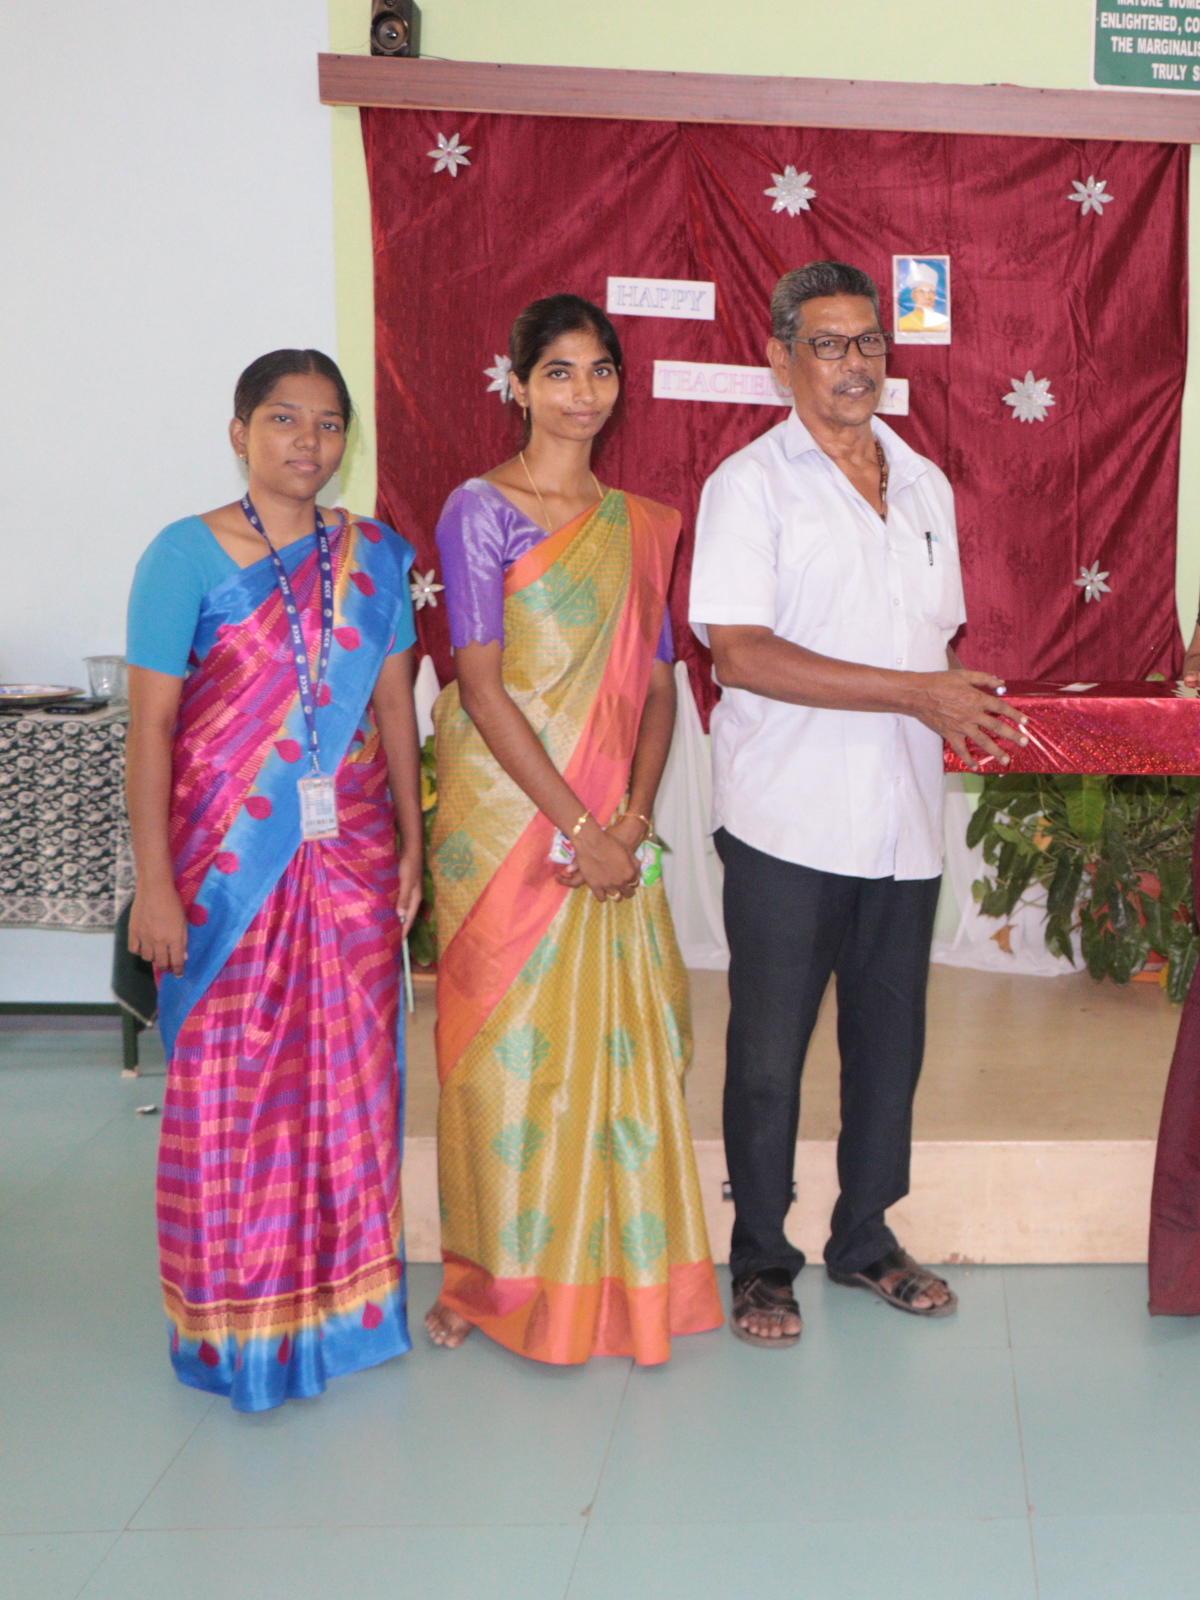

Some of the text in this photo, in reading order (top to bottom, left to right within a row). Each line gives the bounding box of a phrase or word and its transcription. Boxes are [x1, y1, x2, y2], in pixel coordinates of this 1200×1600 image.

[1100, 12, 1182, 35] ENLIGHTENED,
[1111, 36, 1134, 53] THE
[1151, 63, 1188, 81] TRULY
[616, 284, 707, 312] HAPPY
